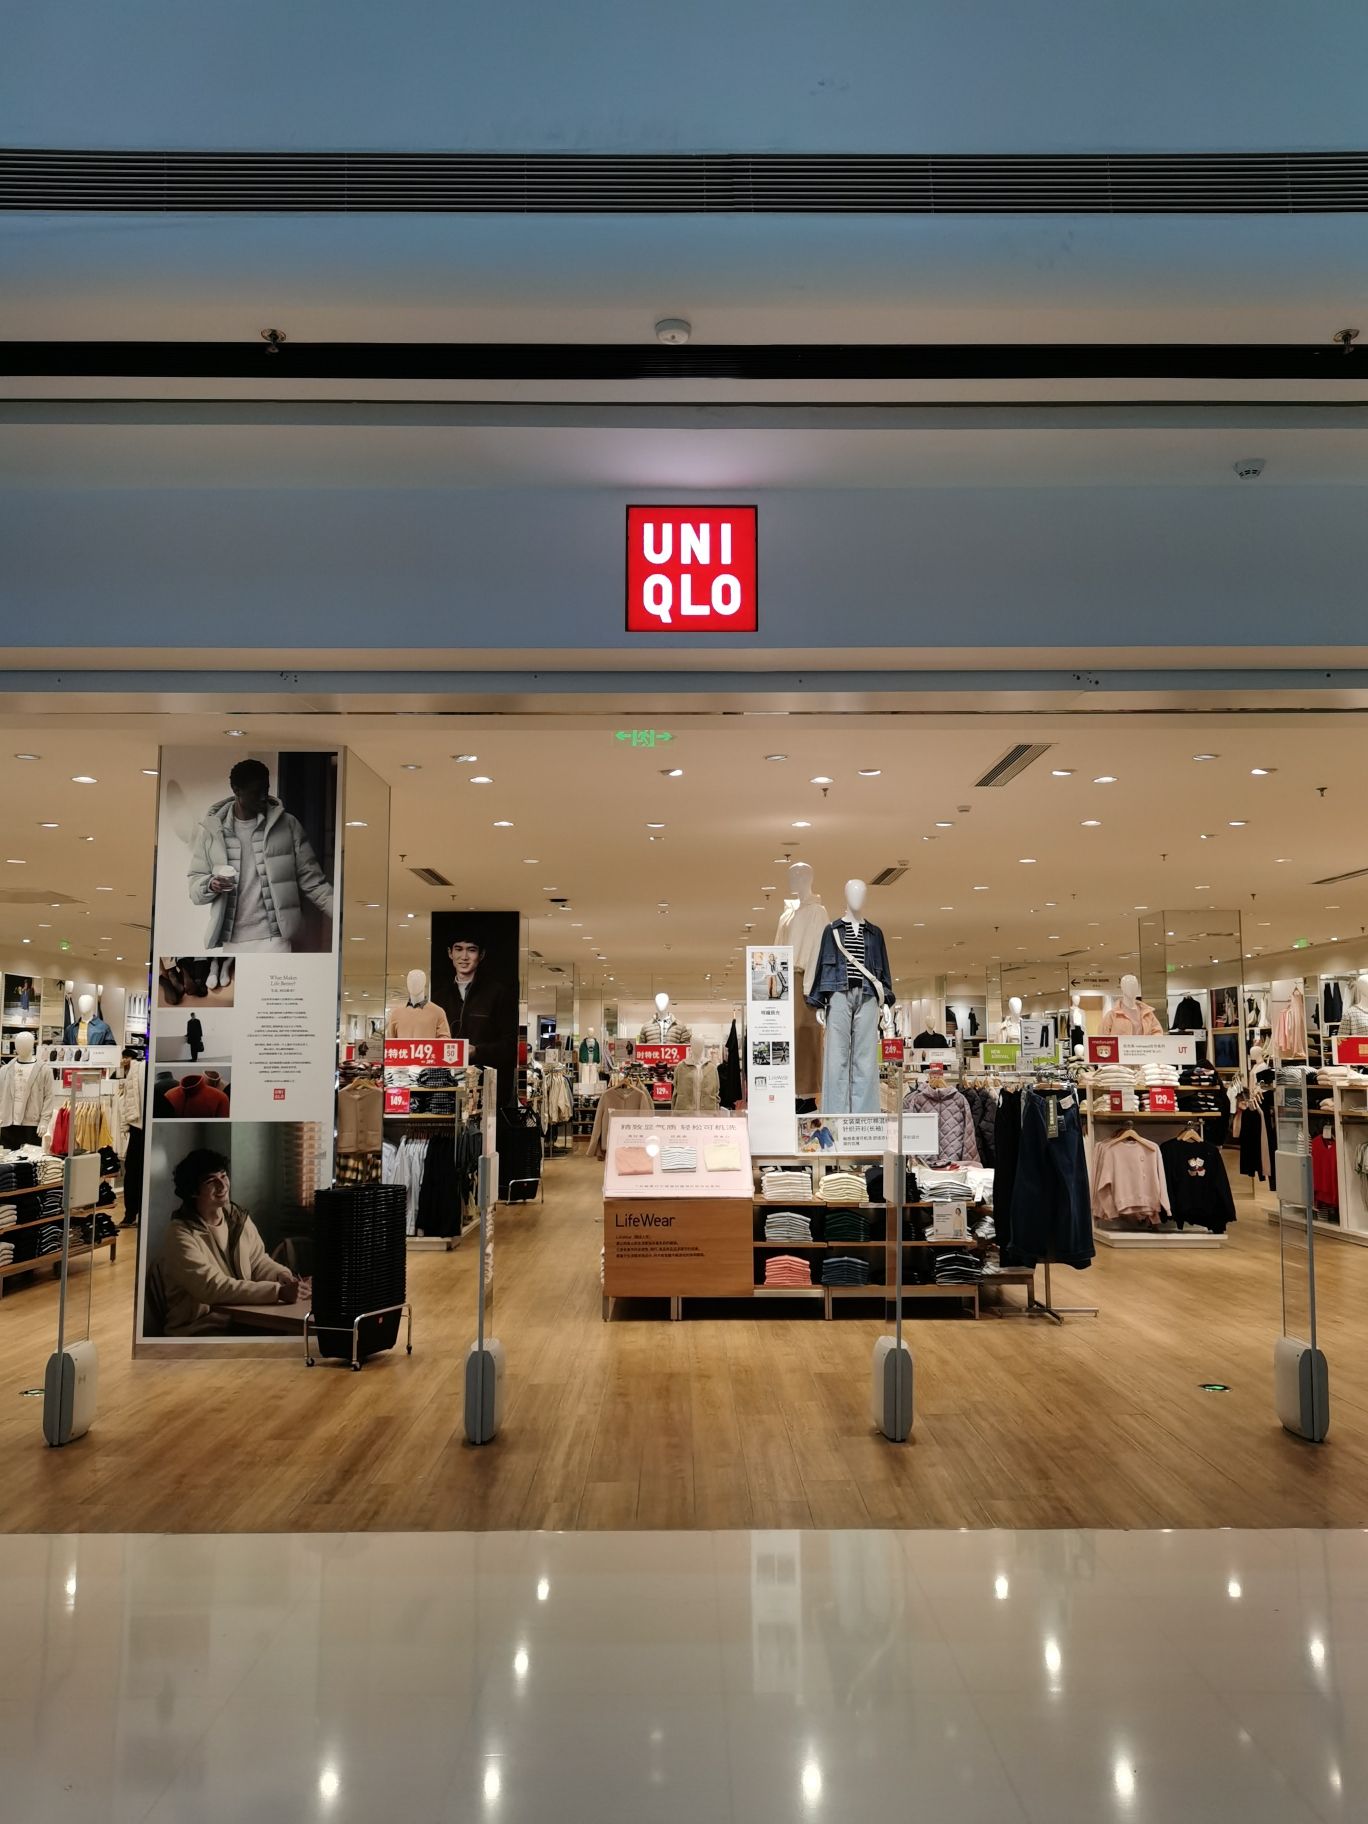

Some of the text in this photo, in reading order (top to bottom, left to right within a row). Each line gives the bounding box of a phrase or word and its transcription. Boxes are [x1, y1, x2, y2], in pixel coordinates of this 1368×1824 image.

[643, 522, 732, 565] UNI
[643, 573, 742, 623] QLO
[1155, 1094, 1168, 1105] 129
[615, 1213, 676, 1228] LifeWear
